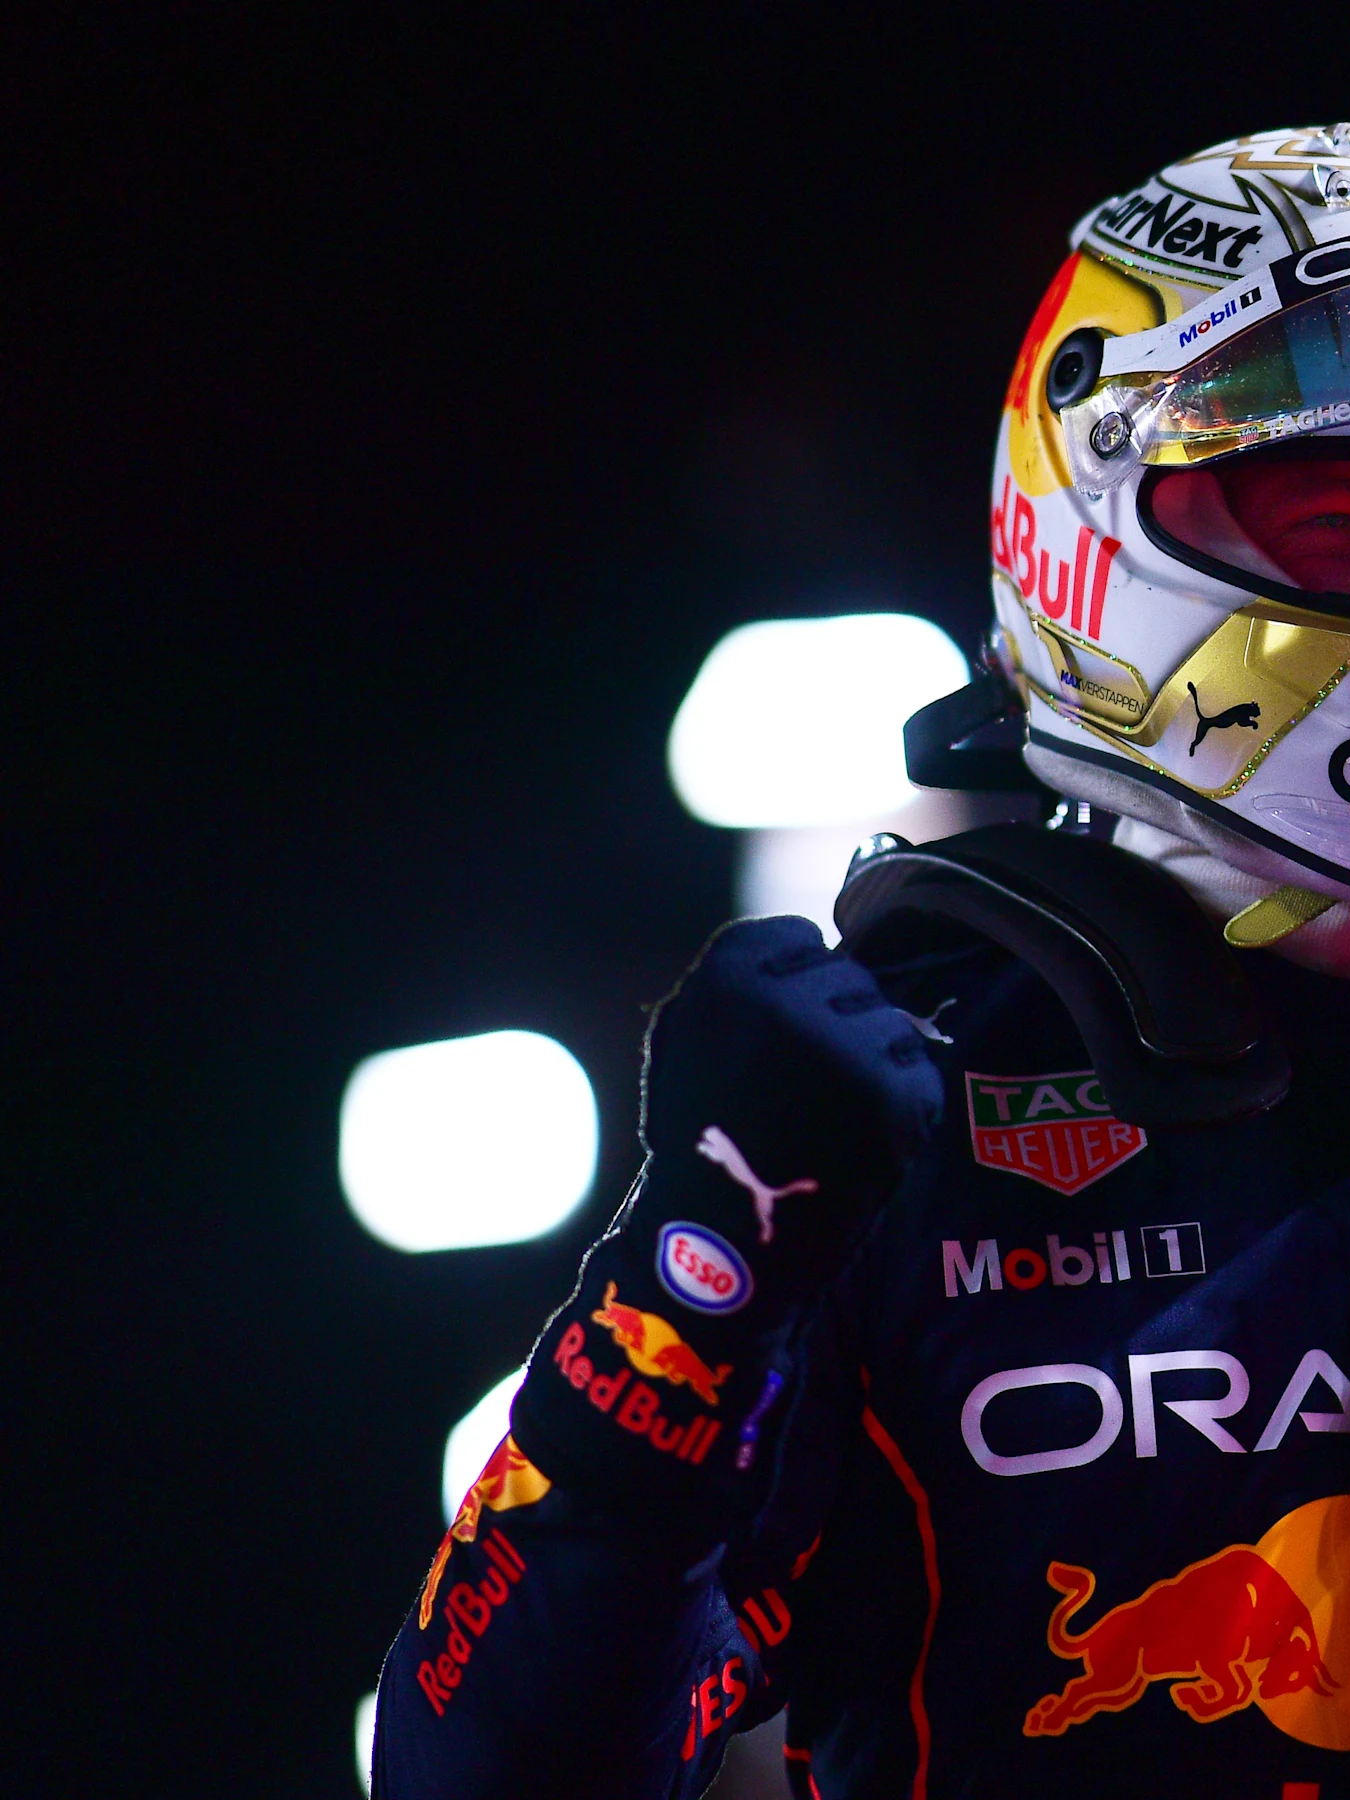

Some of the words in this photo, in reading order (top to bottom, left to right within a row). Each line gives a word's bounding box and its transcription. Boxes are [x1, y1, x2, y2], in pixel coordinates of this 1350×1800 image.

[1101, 194, 1263, 268] arNext
[1179, 299, 1238, 348] Mobil
[1012, 492, 1122, 641] Bull
[982, 1123, 1134, 1184] HEUER
[941, 1230, 1132, 1298] Mobil
[553, 1320, 633, 1414] Red
[615, 1379, 723, 1467] Bull
[416, 1603, 473, 1717] Red
[447, 1526, 528, 1638] Bull
